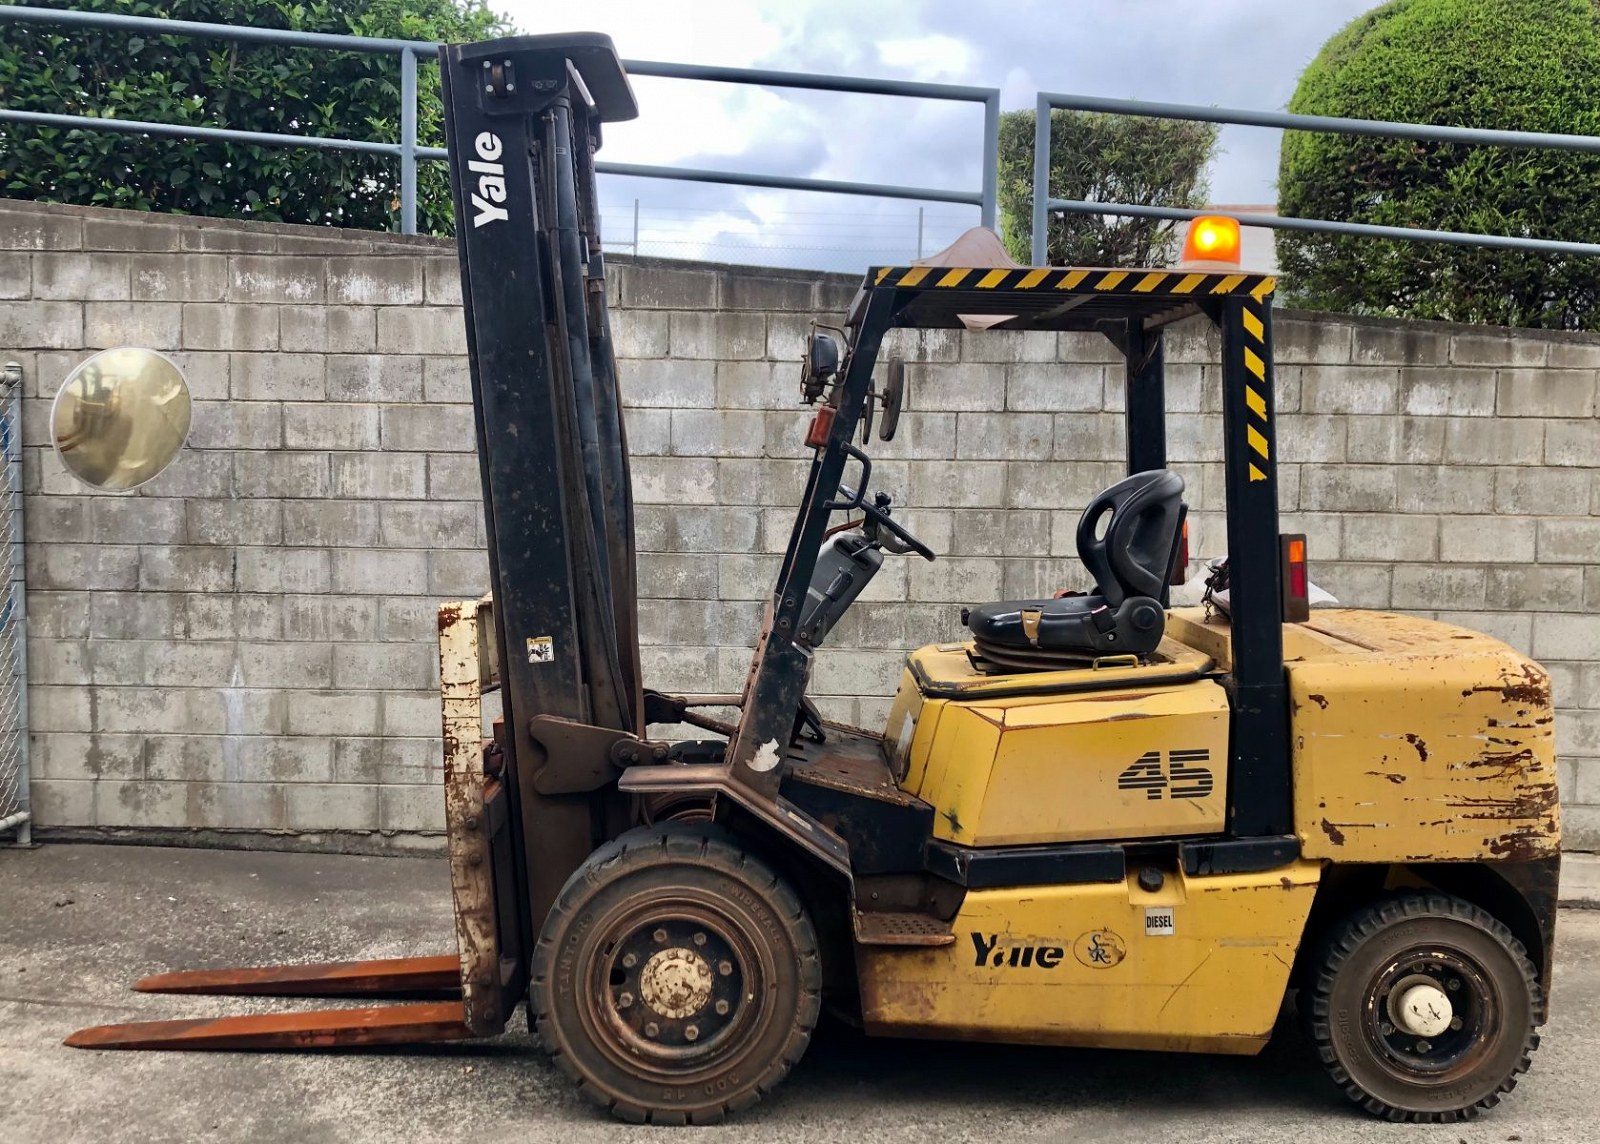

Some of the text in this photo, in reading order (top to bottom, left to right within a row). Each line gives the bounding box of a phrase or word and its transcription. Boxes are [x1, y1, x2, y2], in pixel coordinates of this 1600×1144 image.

[467, 131, 509, 229] Yale
[1118, 749, 1213, 800] 45
[1146, 915, 1173, 928] DIESEL
